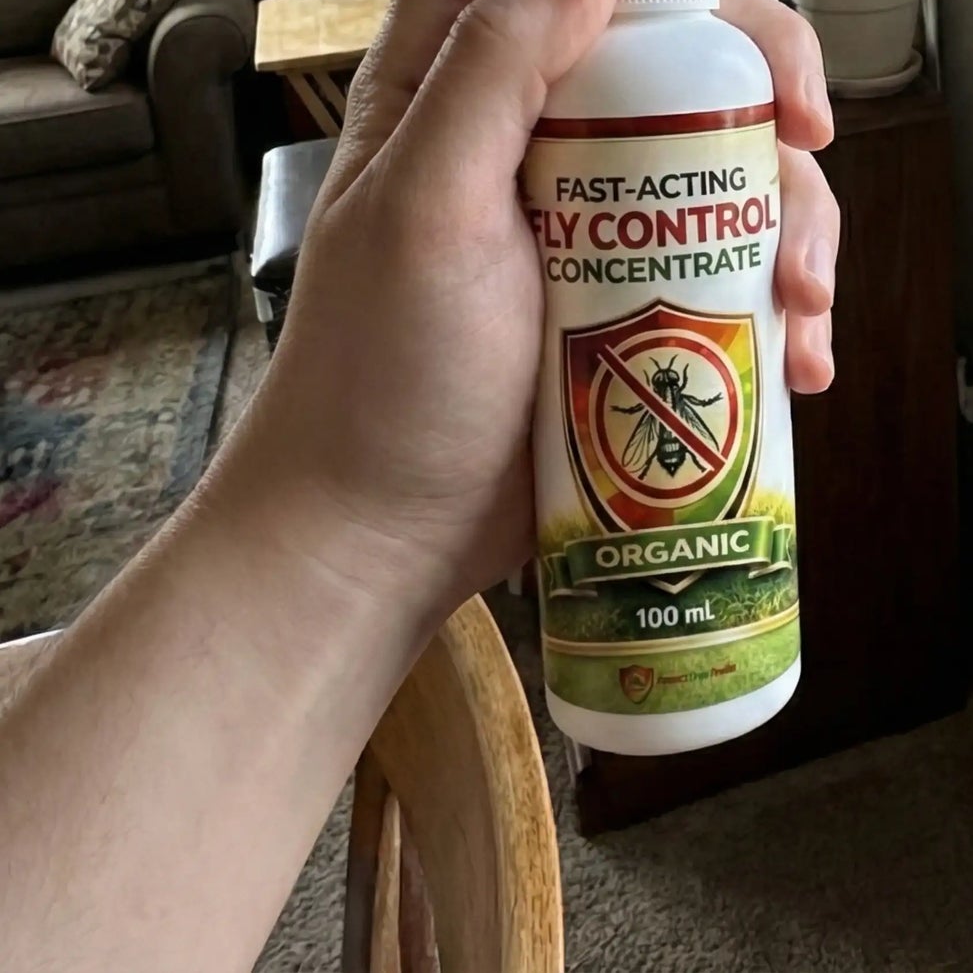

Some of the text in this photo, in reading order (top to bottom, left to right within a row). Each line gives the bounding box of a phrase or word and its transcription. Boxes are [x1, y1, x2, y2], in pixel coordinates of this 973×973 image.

[556, 168, 746, 202] FAST-ACTING
[530, 194, 776, 250] FLY CONTROL
[547, 242, 761, 284] CONCENTRATE
[596, 530, 750, 567] ORGANIC
[636, 599, 715, 628] 100 mL
